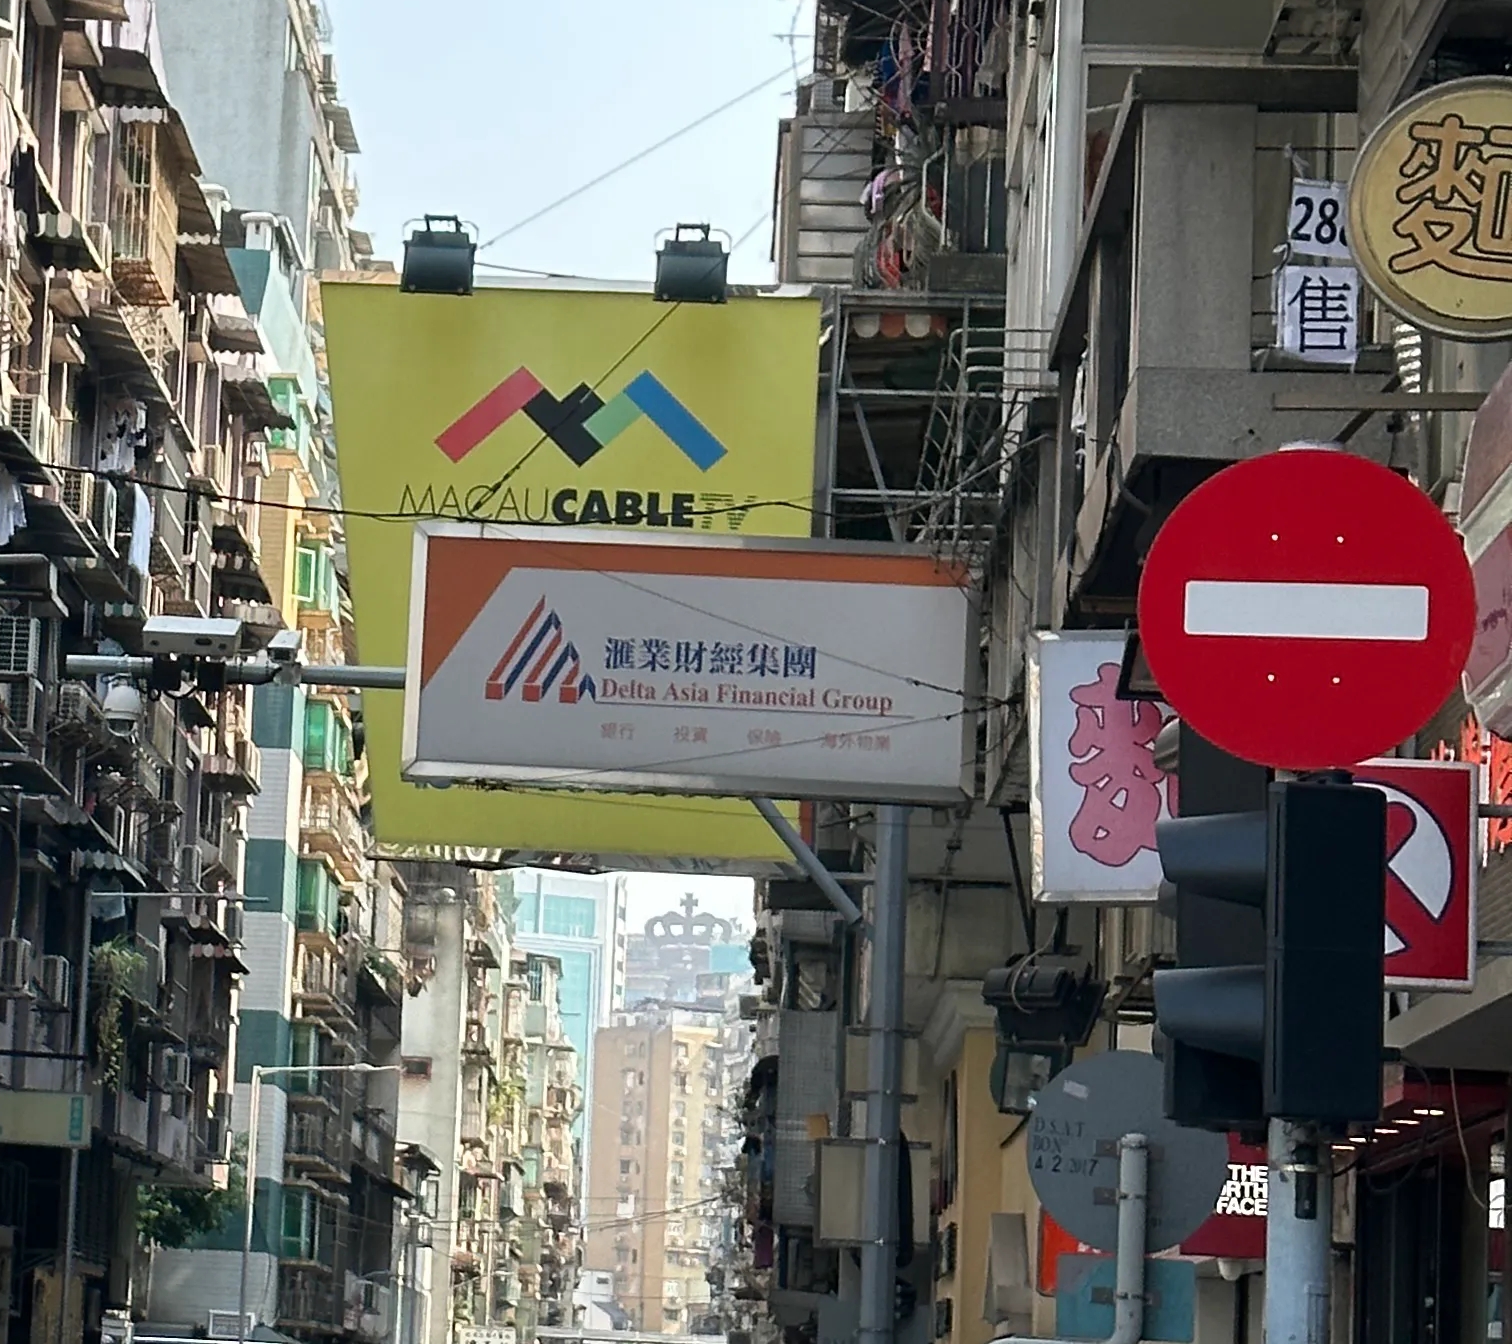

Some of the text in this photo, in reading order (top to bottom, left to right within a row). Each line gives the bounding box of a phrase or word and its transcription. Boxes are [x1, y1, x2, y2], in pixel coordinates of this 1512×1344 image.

[1288, 275, 1354, 353] 售
[600, 678, 893, 717] Delta Asia Financial Group
[1226, 1164, 1269, 1182] THE
[1221, 1181, 1268, 1198] RTH
[1216, 1198, 1268, 1216] FACE
